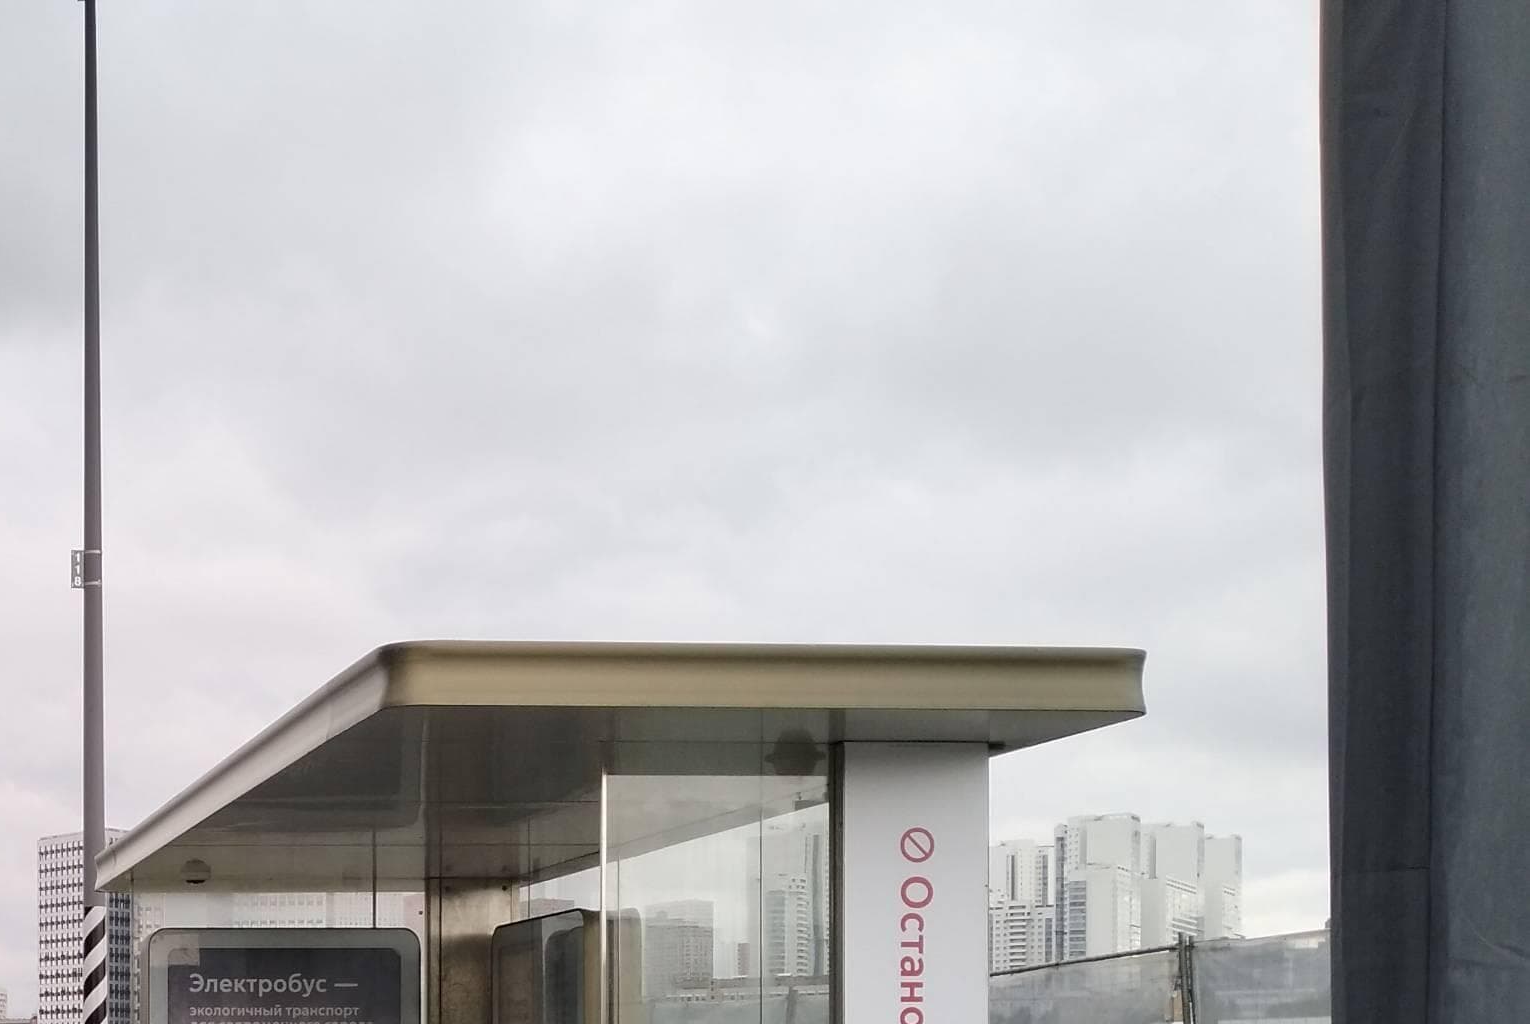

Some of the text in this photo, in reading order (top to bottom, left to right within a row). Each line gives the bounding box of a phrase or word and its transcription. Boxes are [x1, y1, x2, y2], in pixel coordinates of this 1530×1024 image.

[74, 552, 82, 587] 118
[189, 973, 327, 998] Электробус
[189, 1004, 360, 1019] экологичный транспорт
